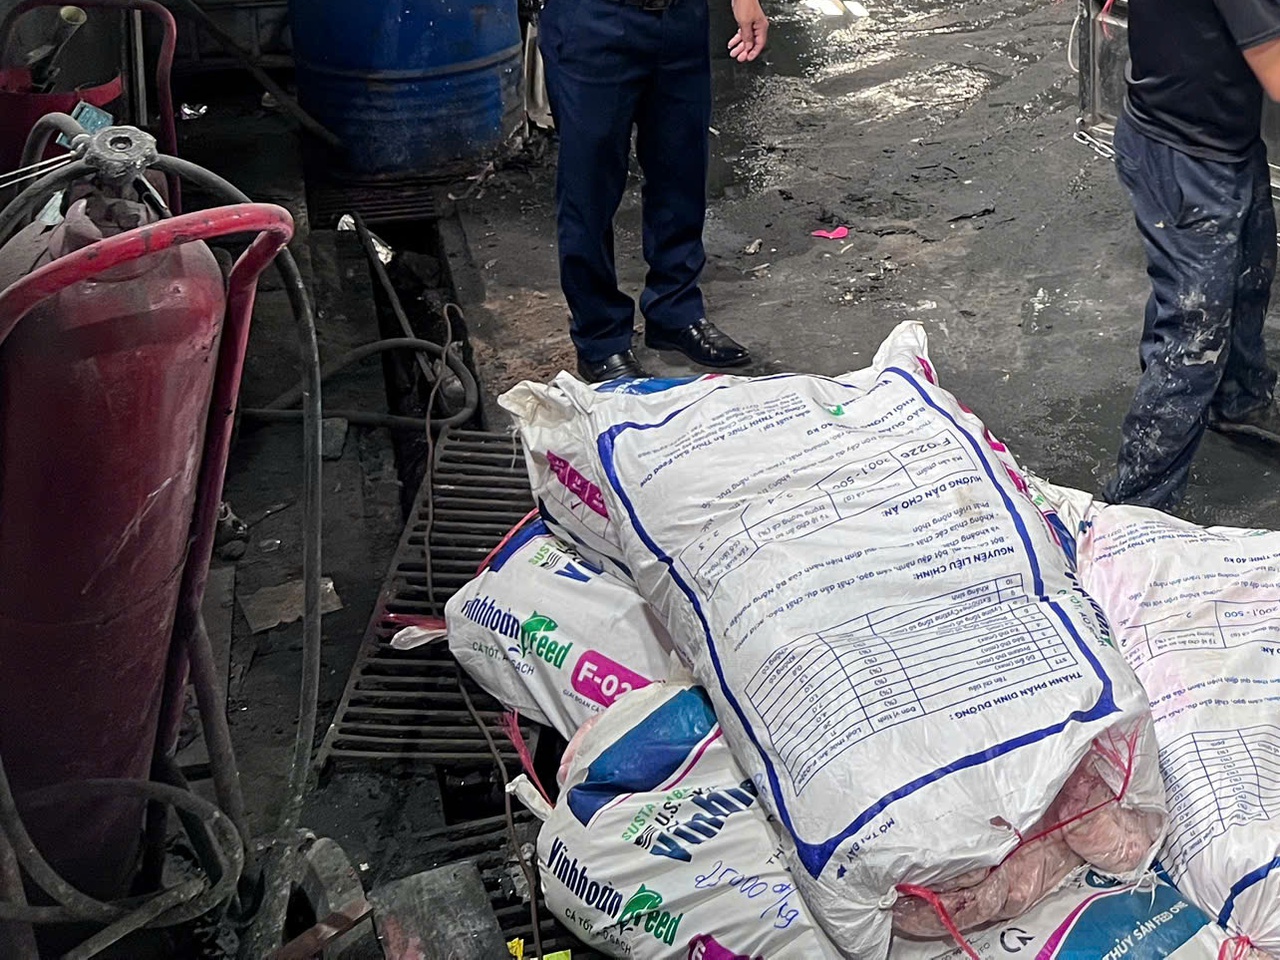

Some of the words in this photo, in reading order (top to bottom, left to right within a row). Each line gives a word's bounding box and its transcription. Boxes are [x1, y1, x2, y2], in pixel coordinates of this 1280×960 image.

[652, 457, 673, 474] Feed
[923, 483, 948, 501] DẪN
[900, 494, 923, 509] CHO
[880, 505, 900, 518] ĂN:
[931, 511, 953, 525] nông
[911, 521, 931, 533] thôn
[916, 553, 933, 565] đậu
[933, 548, 948, 559] bột
[972, 543, 1014, 563] NGUYÊN
[948, 555, 972, 572] LIỆU
[912, 563, 947, 583] CHÍNH:
[836, 576, 855, 588] chất
[785, 594, 803, 609] chất
[951, 591, 966, 601] sinh
[980, 604, 1002, 617] Lysine
[916, 617, 934, 629] tổng
[868, 666, 882, 675] (%)
[577, 661, 633, 702] F-02
[873, 676, 887, 686] (%)
[1047, 670, 1082, 688] THÀNH
[878, 687, 892, 696] (%)
[1019, 681, 1047, 698] PHẦN
[883, 698, 897, 707] (%)
[992, 691, 1018, 705] DINH
[655, 800, 682, 826] U.S.
[1134, 919, 1157, 940] SẢN
